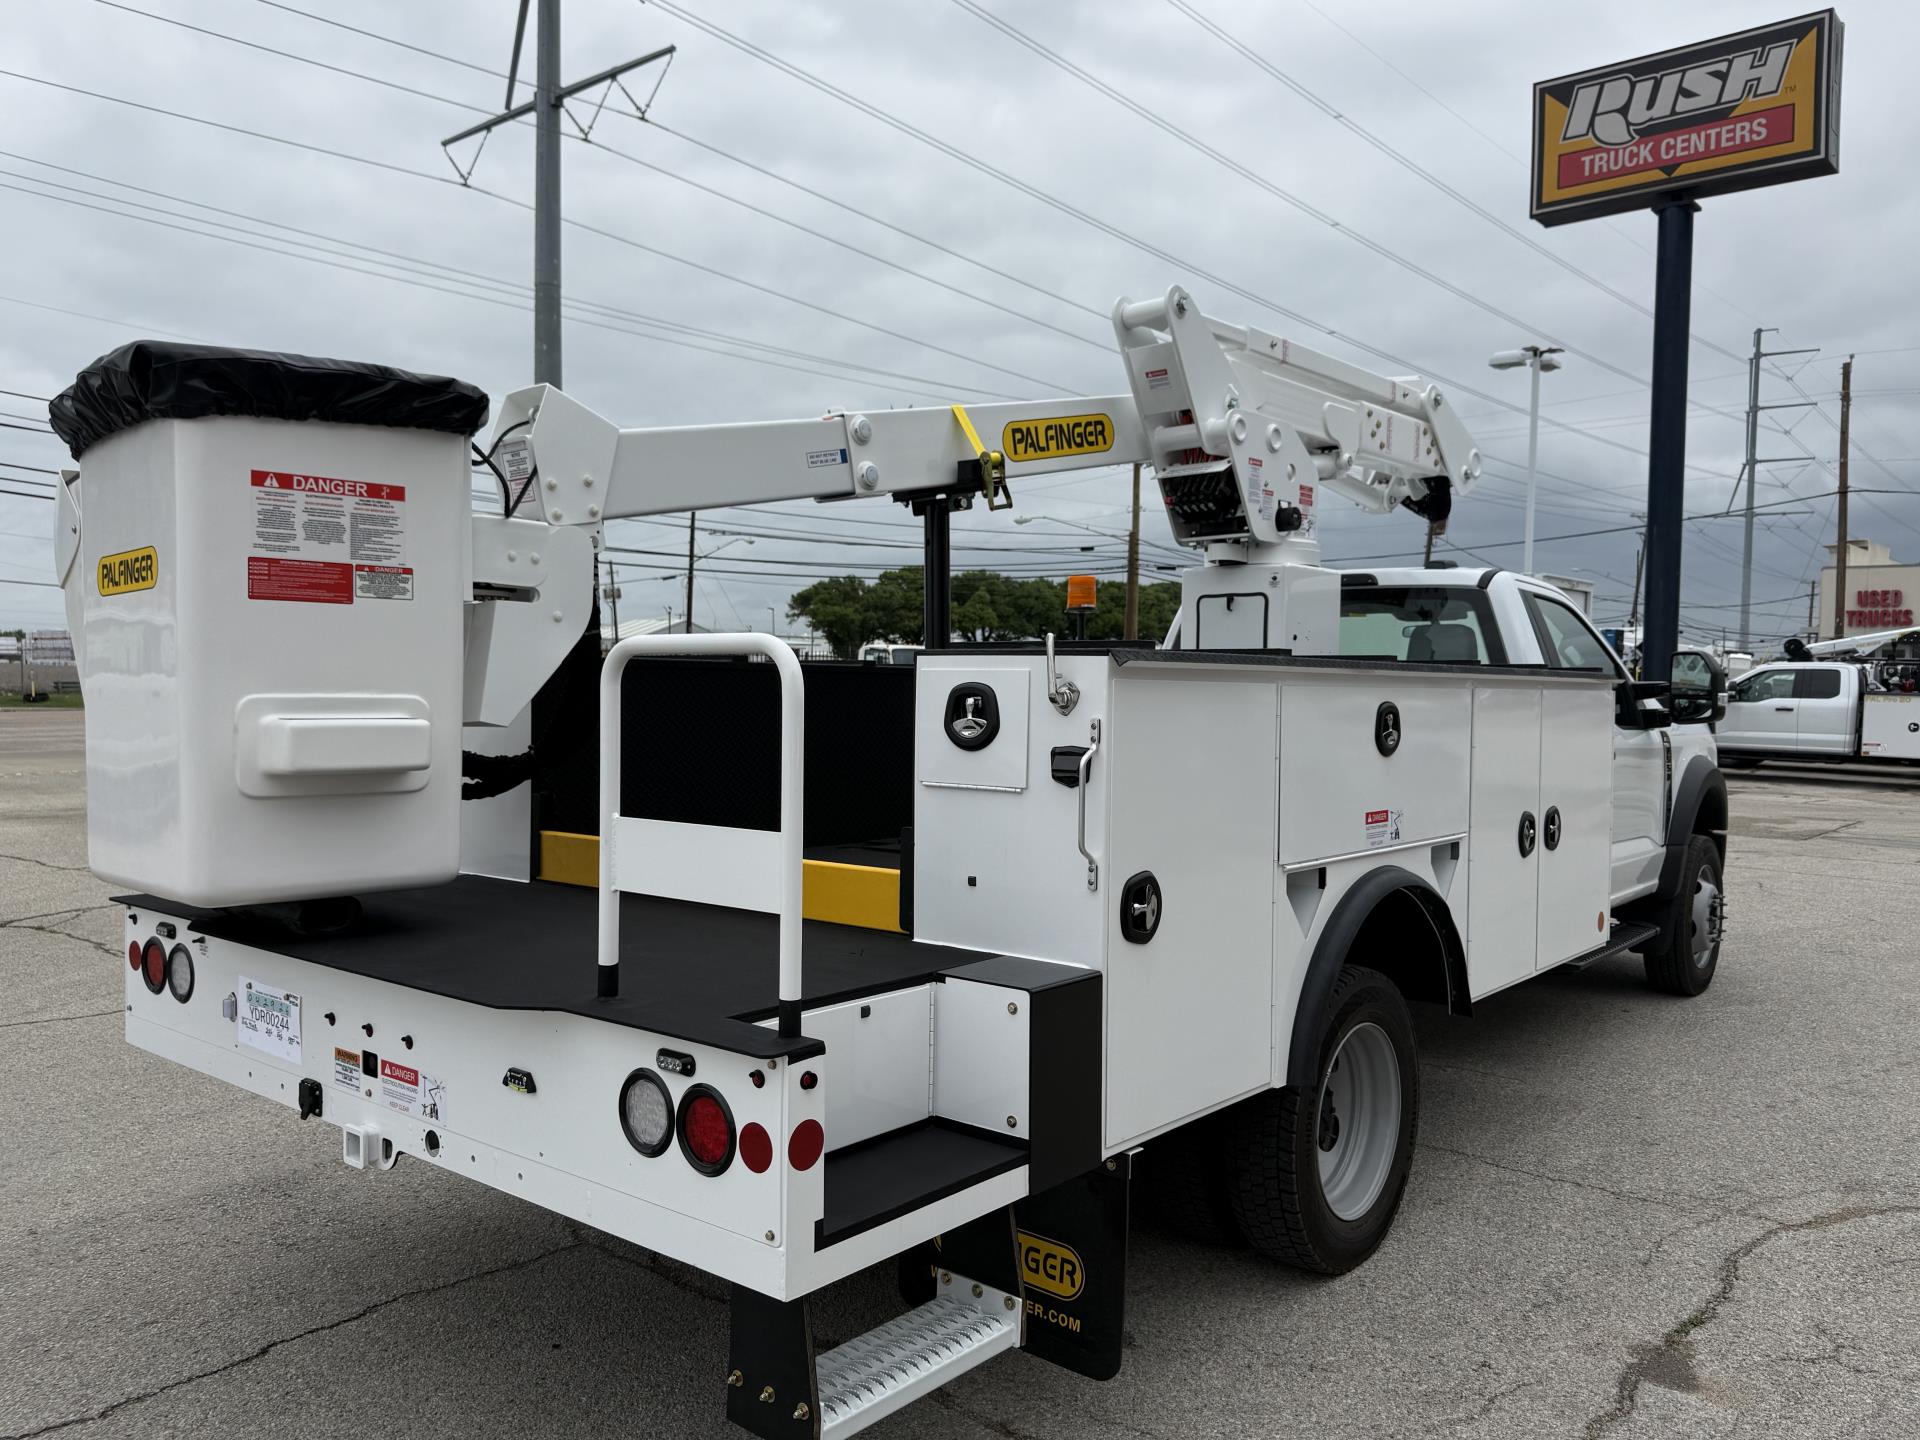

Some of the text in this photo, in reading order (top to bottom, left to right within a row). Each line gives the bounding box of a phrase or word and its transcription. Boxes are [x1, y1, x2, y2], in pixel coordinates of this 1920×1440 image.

[1580, 117, 1769, 178] TRUCK CENTERS
[1011, 420, 1107, 455] PALFINGER
[293, 475, 368, 497] DANGER
[102, 555, 154, 589] PALFINGER
[375, 566, 404, 574] DANGER
[1857, 589, 1903, 608] USED
[1846, 609, 1914, 628] TRUCKS
[391, 1066, 416, 1083] DANGER
[1018, 1242, 1077, 1289] GER
[1025, 1300, 1081, 1333] ER.COM
